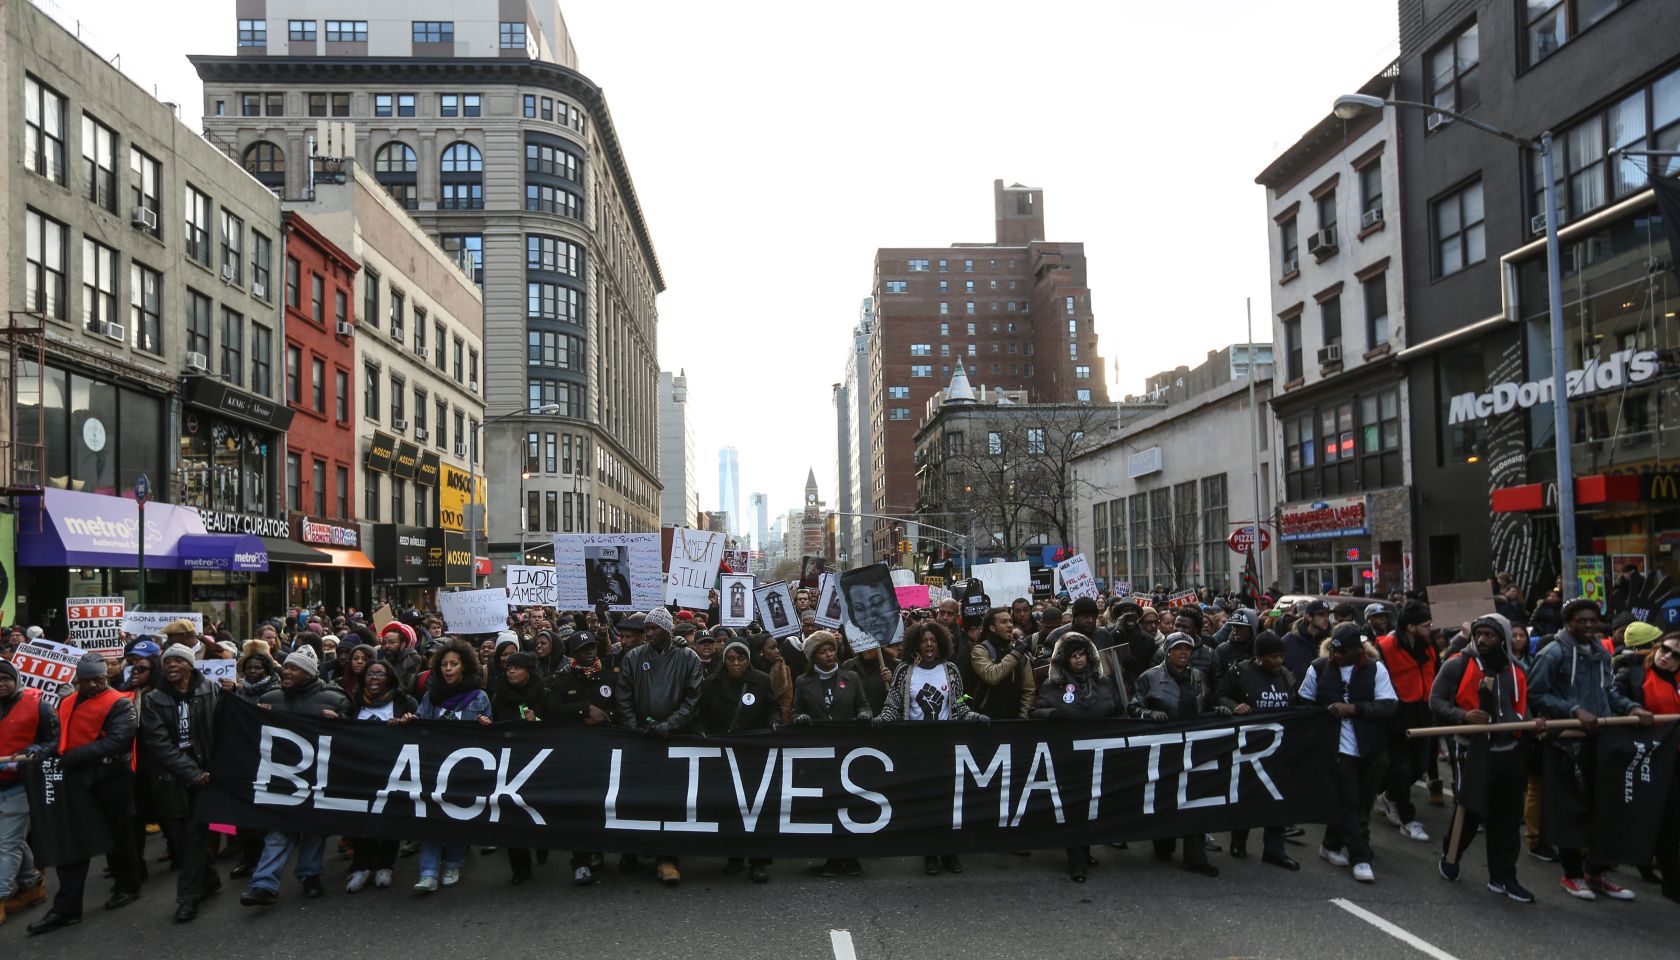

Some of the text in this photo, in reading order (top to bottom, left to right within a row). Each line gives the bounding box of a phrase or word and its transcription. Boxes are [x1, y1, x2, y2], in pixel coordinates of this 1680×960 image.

[1449, 350, 1659, 425] McDonald's
[373, 446, 392, 459] MOSCOT
[399, 455, 415, 467] MOSCOT
[421, 464, 437, 474] MOSCOT
[200, 510, 290, 538] BEAUTY CURATORS
[184, 558, 229, 567] metroPCS
[235, 552, 268, 563] metroPCS
[447, 550, 471, 566] MOSCOT
[672, 566, 711, 590] STILL
[70, 606, 122, 618] STOP
[1669, 608, 1677, 622] P
[69, 619, 122, 629] POLICE
[81, 639, 124, 650] MURDER
[16, 655, 72, 680] STOP
[252, 723, 1285, 834] BLACK LIVES MATTER
